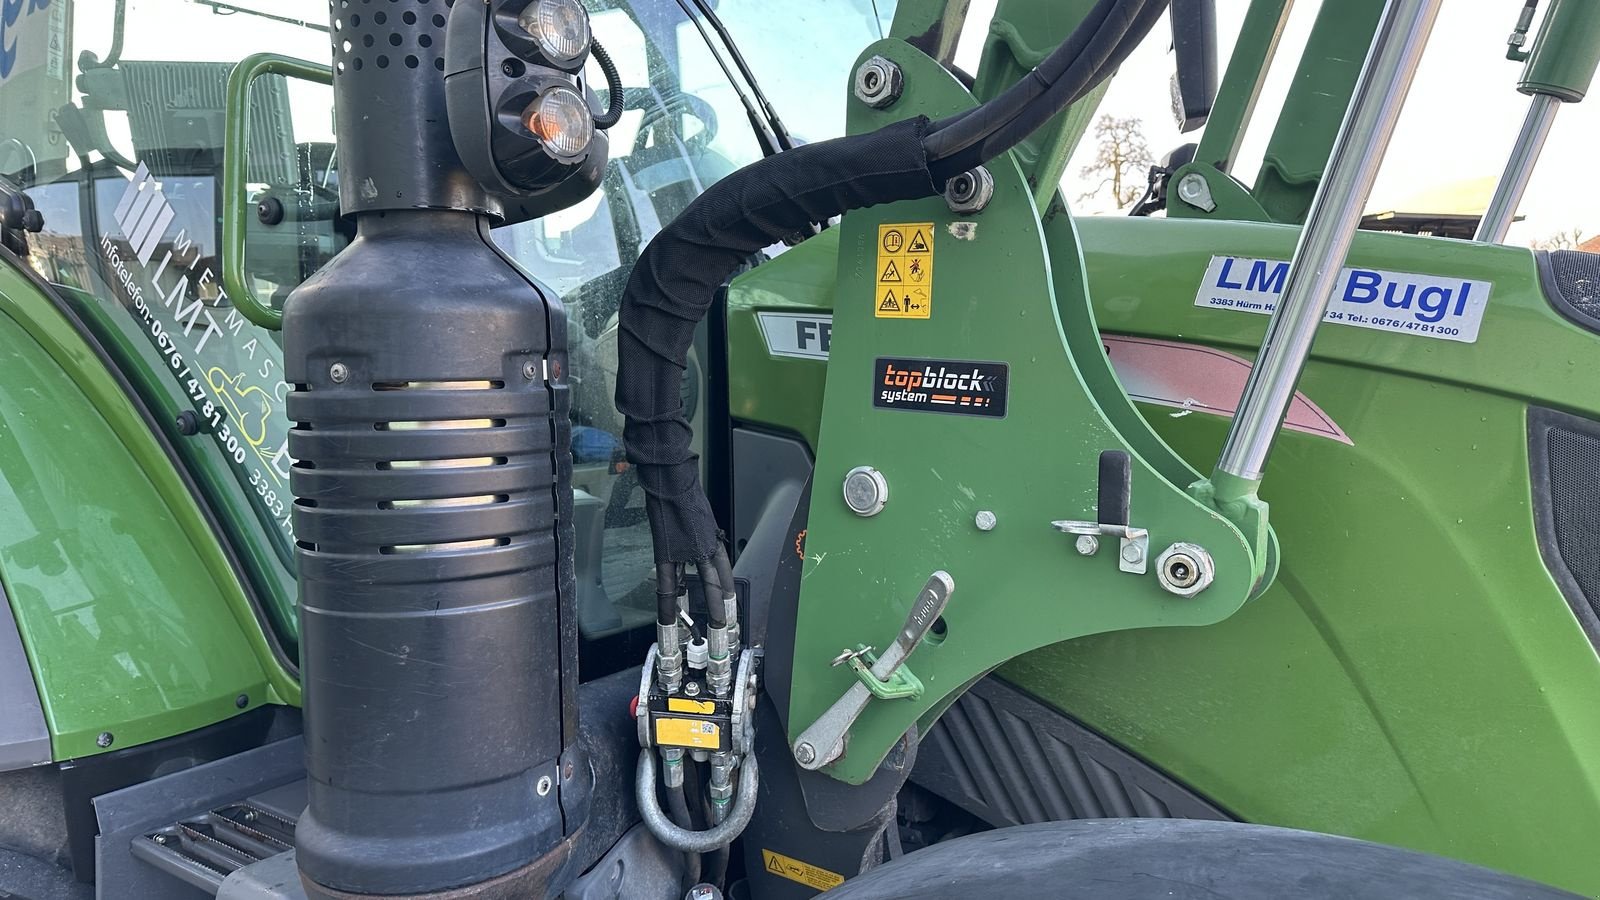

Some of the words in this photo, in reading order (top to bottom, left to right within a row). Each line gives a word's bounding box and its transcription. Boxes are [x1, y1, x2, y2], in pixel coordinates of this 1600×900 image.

[152, 250, 224, 353] LMT
[1209, 297, 1234, 307] 3383
[1235, 300, 1262, 310] Hürm
[1371, 317, 1460, 337] 0676/4781300
[1342, 270, 1472, 323] Bugl
[100, 231, 154, 325] Infotelefon:
[151, 319, 183, 369] 0676
[187, 378, 207, 401] 47
[202, 400, 222, 428] 81
[217, 424, 246, 465] 300
[248, 468, 284, 517] 3383
[880, 390, 927, 403] system
[884, 364, 984, 392] topblock
